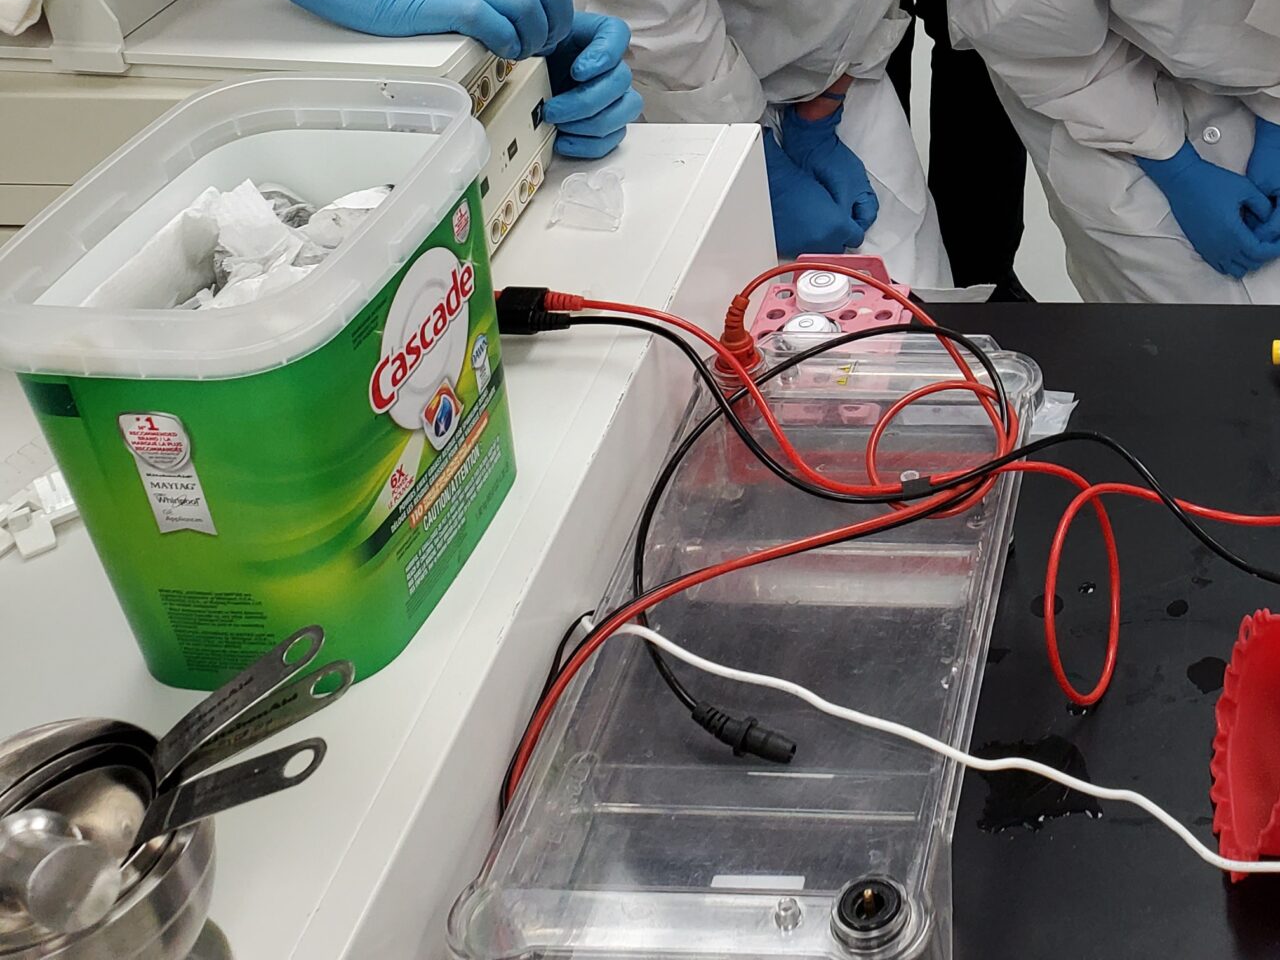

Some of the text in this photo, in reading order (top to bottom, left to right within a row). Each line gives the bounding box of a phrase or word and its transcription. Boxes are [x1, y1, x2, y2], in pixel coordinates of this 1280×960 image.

[371, 264, 473, 410] Cascade
[150, 481, 196, 490] MAYTAG
[390, 464, 406, 489] 6X
